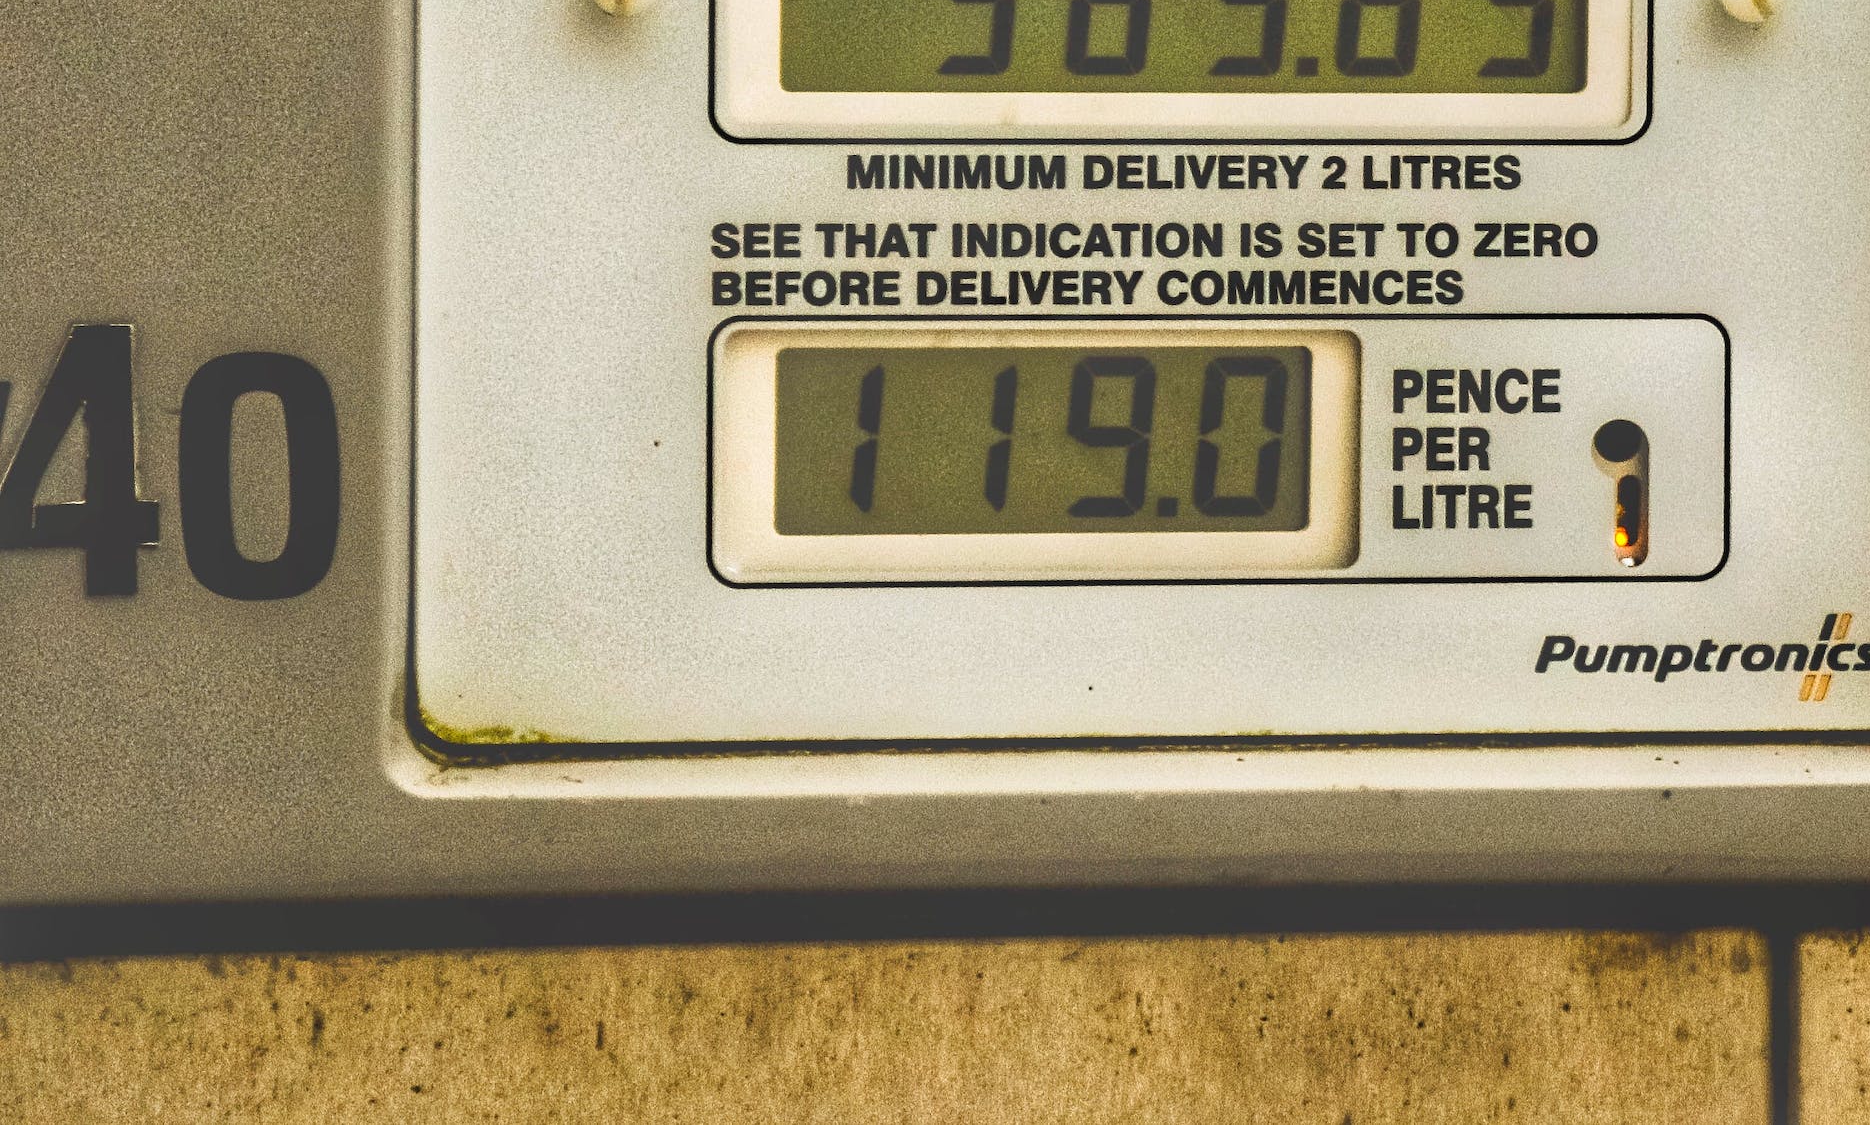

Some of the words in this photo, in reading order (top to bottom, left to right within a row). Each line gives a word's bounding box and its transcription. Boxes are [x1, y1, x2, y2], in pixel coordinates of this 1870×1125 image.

[847, 155, 1066, 190] MINIMUM
[1083, 155, 1309, 190] DELIVERY
[1322, 155, 1347, 190] 2
[1363, 154, 1521, 190] LITRES
[711, 222, 801, 259] SEE
[815, 223, 937, 258] THAT
[952, 222, 1223, 259] INDICATION
[1240, 222, 1283, 259] IS
[1297, 222, 1385, 259] SET
[1396, 222, 1459, 258] TO
[1473, 222, 1598, 258] ZERO
[712, 270, 901, 307] BEFORE
[916, 270, 1144, 306] DELIVERY
[1157, 269, 1464, 306] COMMENCES
[1393, 368, 1561, 414] PENCE
[849, 355, 1290, 518] 119.0
[1392, 426, 1490, 472] PER
[0, 323, 341, 601] 40
[1392, 484, 1533, 530] LITRE
